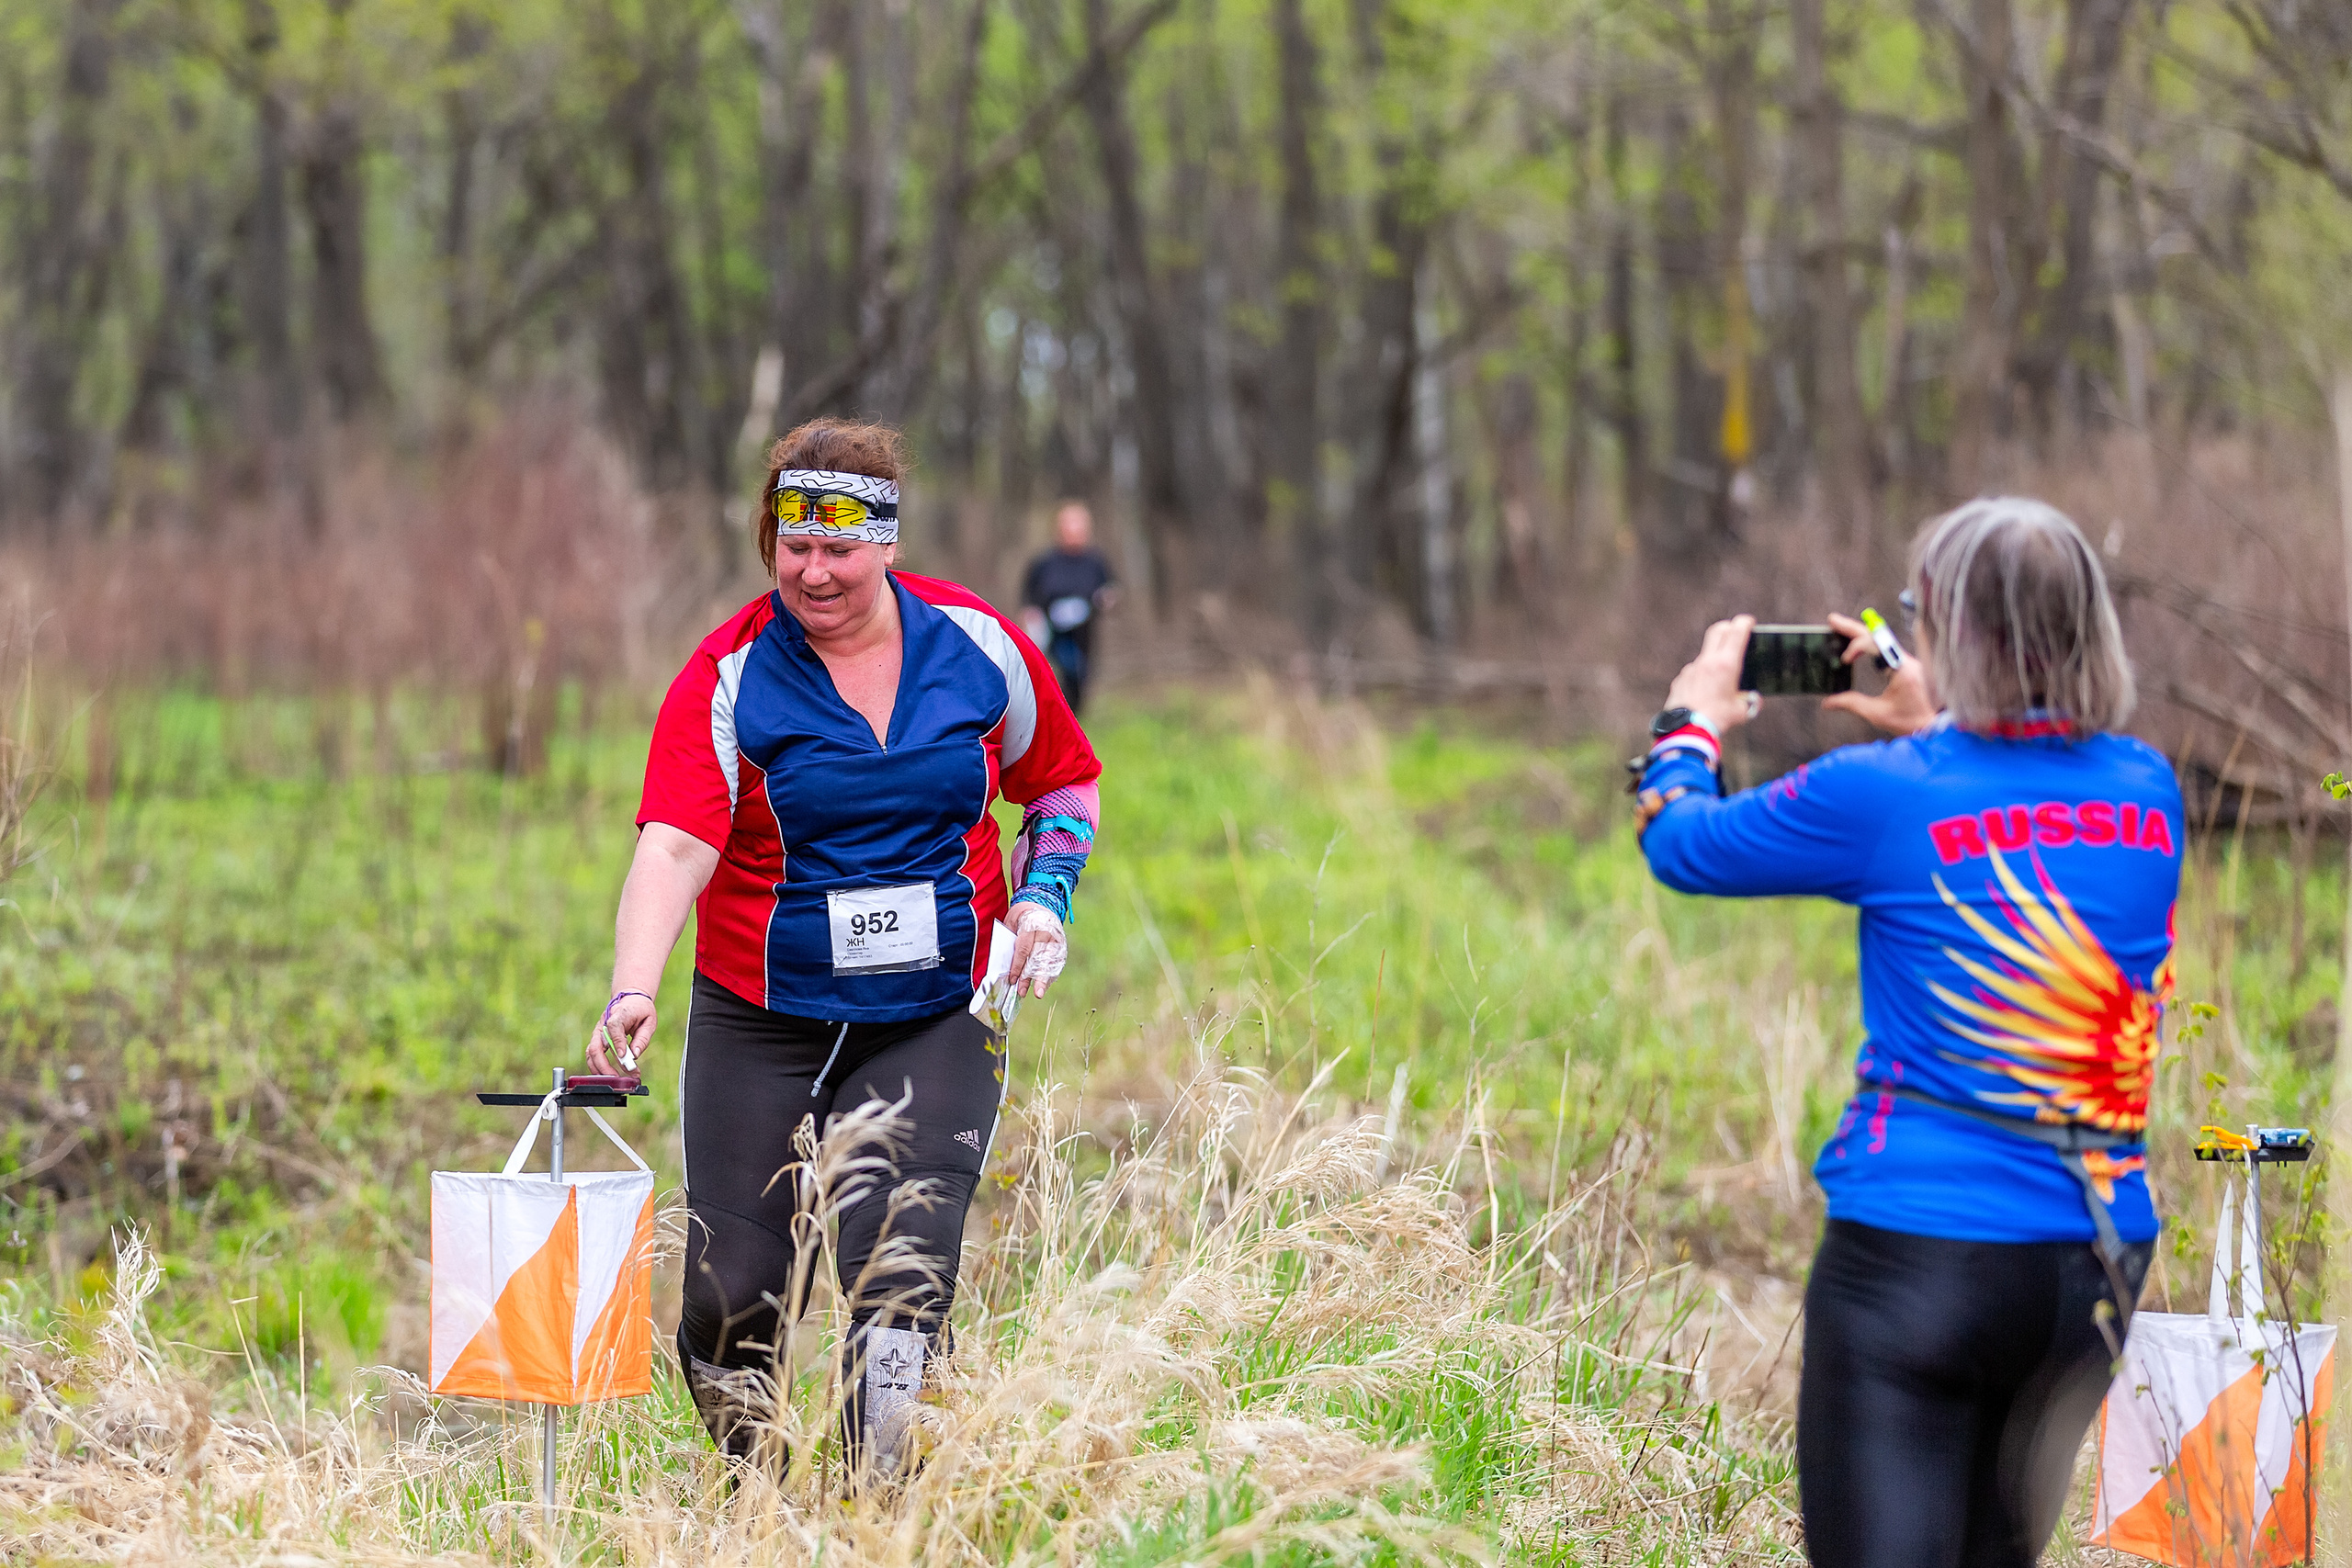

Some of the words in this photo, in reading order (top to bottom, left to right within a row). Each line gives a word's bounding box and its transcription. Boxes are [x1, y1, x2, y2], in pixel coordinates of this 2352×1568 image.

[1929, 801, 2174, 865] RUSSIA
[851, 910, 899, 935] 952
[846, 938, 865, 947] ЖН
[954, 1134, 980, 1152] adidas
